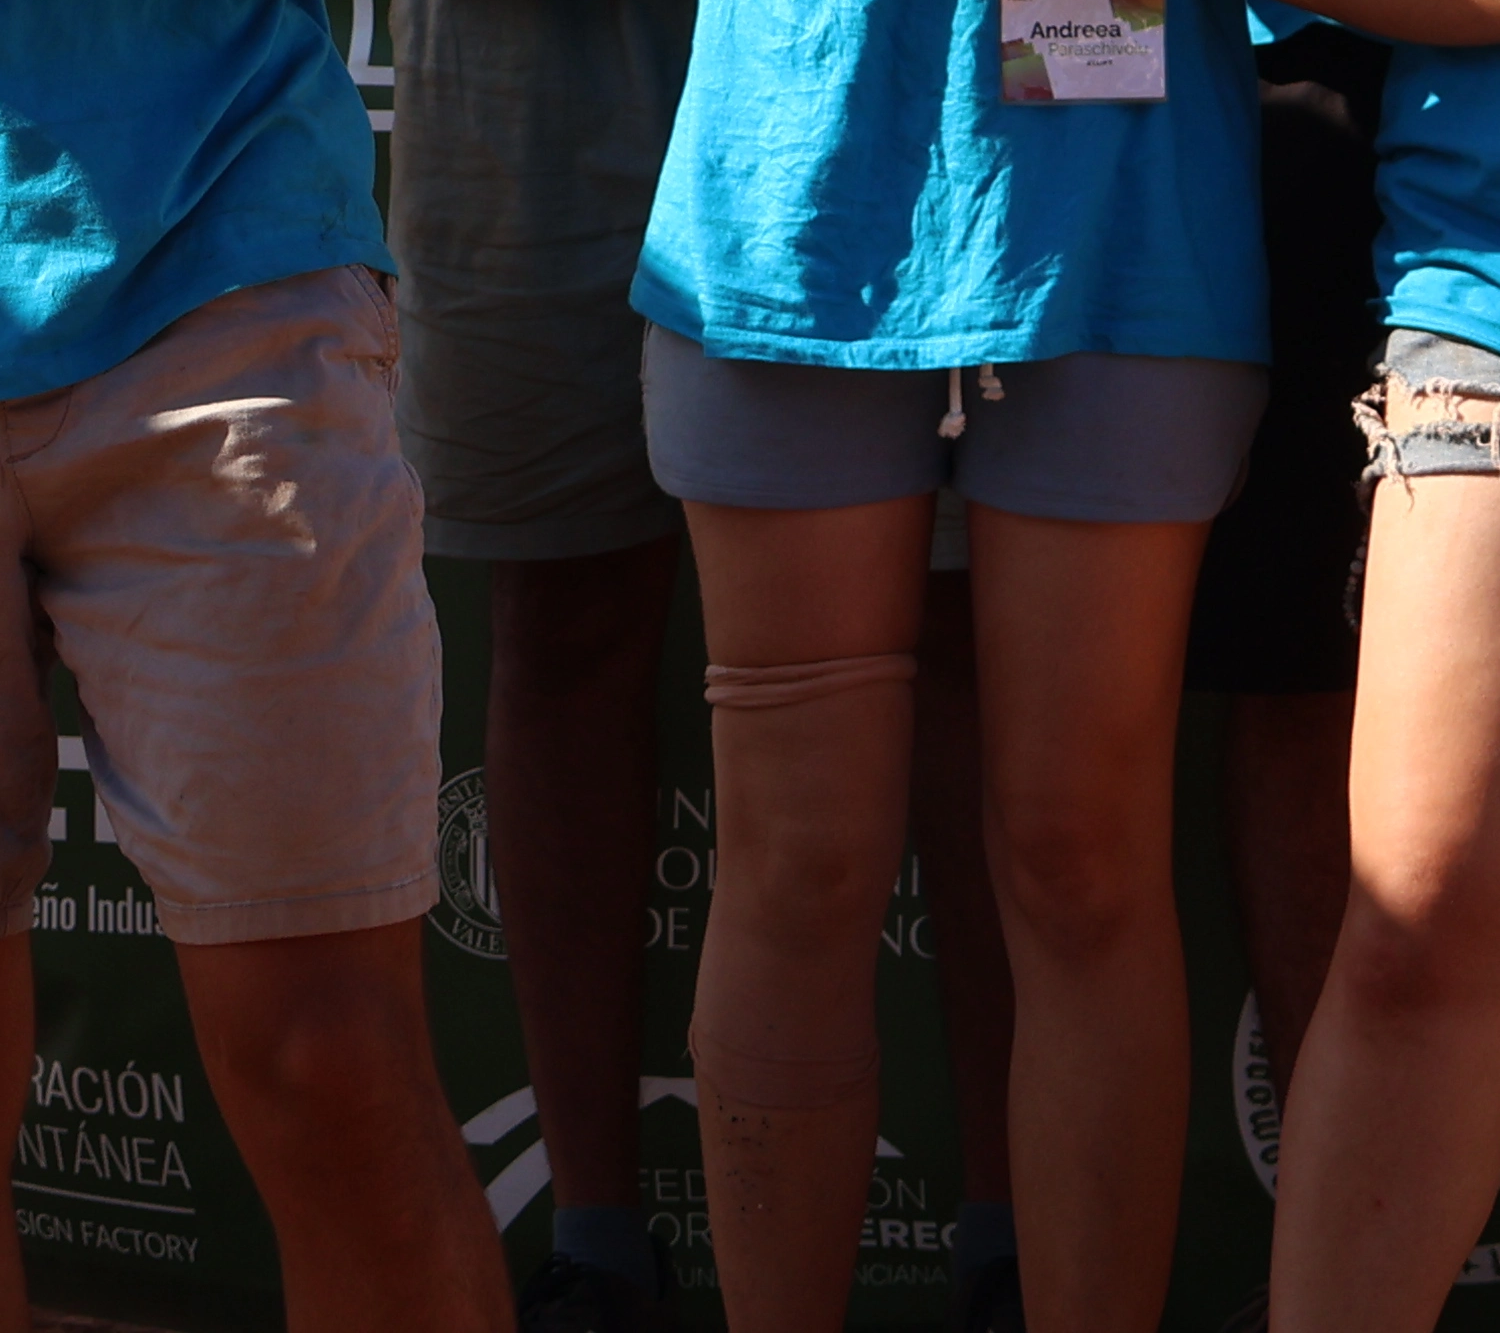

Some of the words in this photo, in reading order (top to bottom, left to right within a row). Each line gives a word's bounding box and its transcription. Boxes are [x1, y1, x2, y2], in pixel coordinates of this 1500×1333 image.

[1030, 20, 1122, 39] Andreea
[31, 1053, 186, 1124] RACIÓN
[17, 1119, 193, 1191] NTÁNEA
[15, 1208, 74, 1244] SIGN
[79, 1219, 199, 1264] FACTORY
